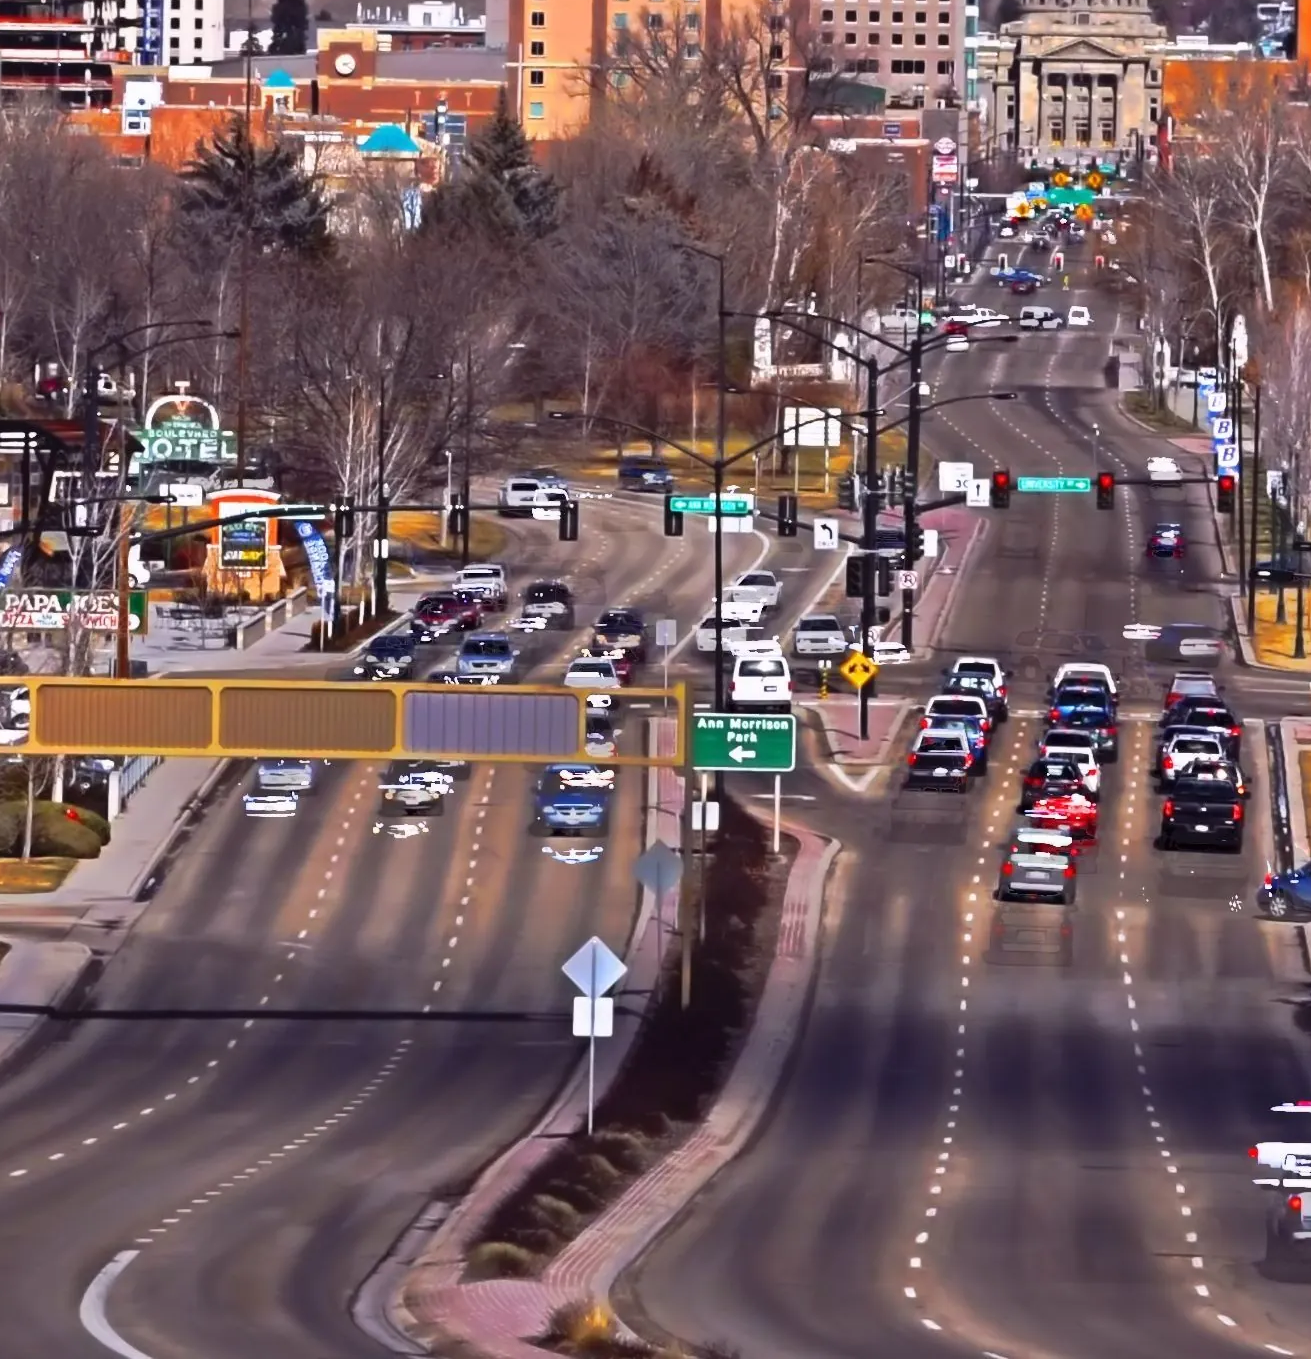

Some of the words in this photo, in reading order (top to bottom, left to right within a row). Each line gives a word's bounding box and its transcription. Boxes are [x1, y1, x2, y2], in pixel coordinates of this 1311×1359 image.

[5, 594, 62, 612] PAPA
[697, 718, 724, 729] Ann
[730, 719, 789, 730] Morrison
[727, 731, 758, 743] Park
